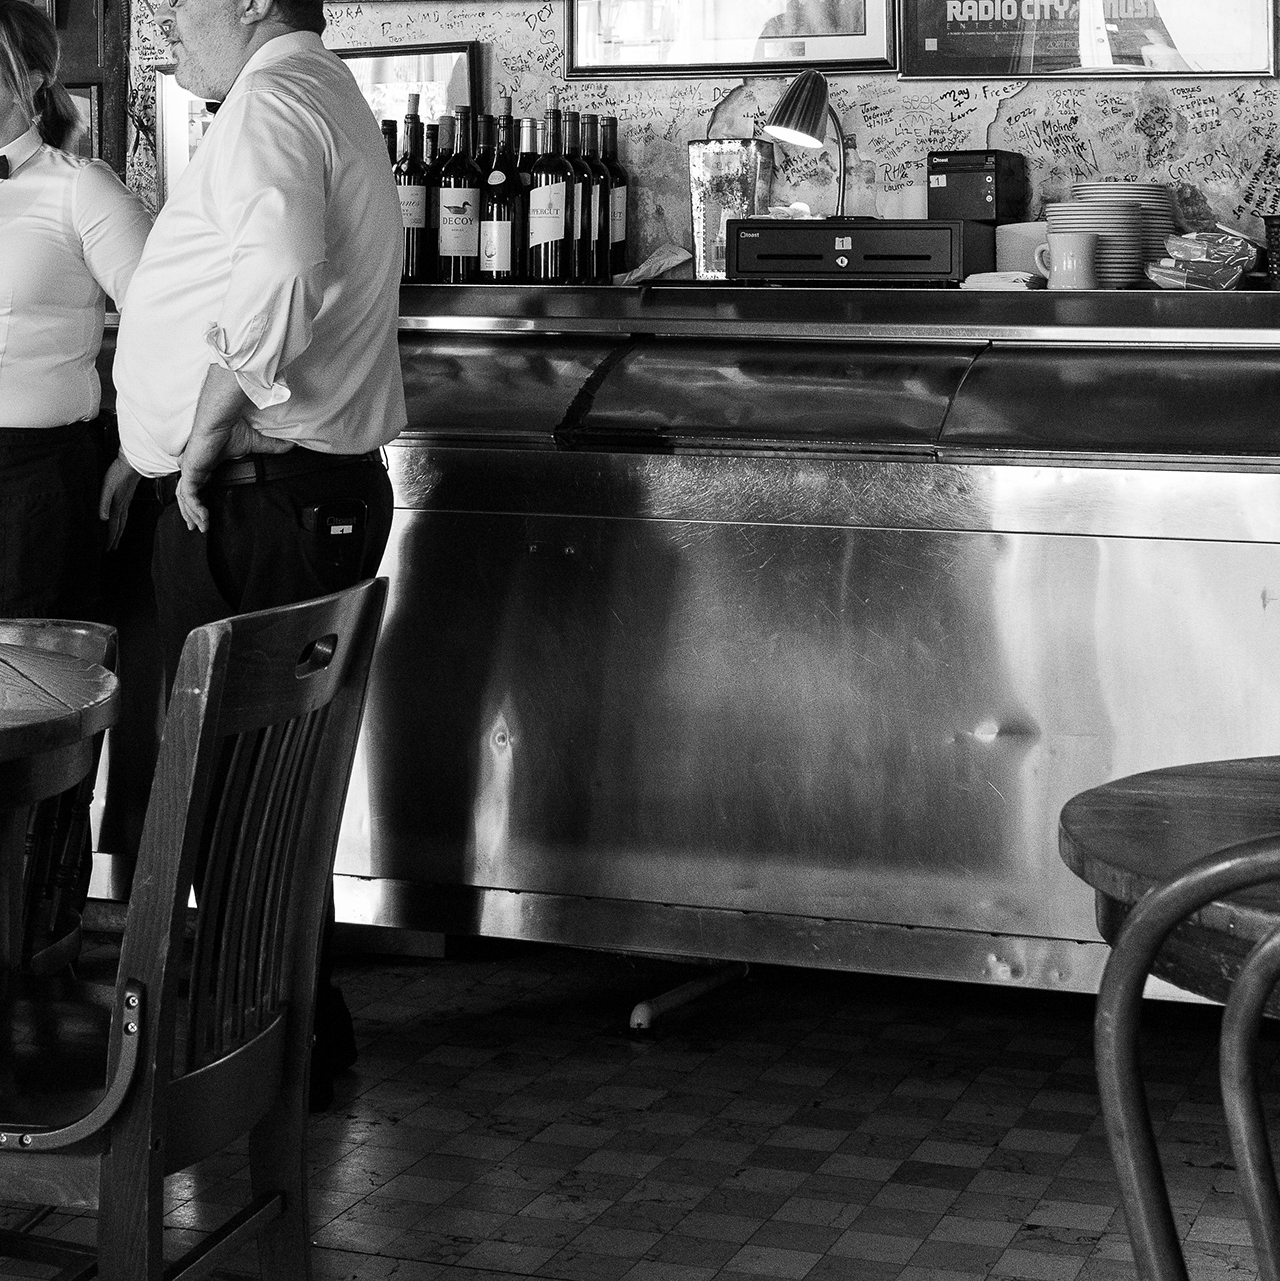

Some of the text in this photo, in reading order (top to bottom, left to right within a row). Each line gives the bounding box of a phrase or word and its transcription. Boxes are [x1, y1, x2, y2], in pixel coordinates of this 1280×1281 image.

[946, 0, 1018, 21] RADIO
[442, 217, 474, 225] DECOY
[743, 230, 760, 238] toast
[840, 239, 845, 248] 1
